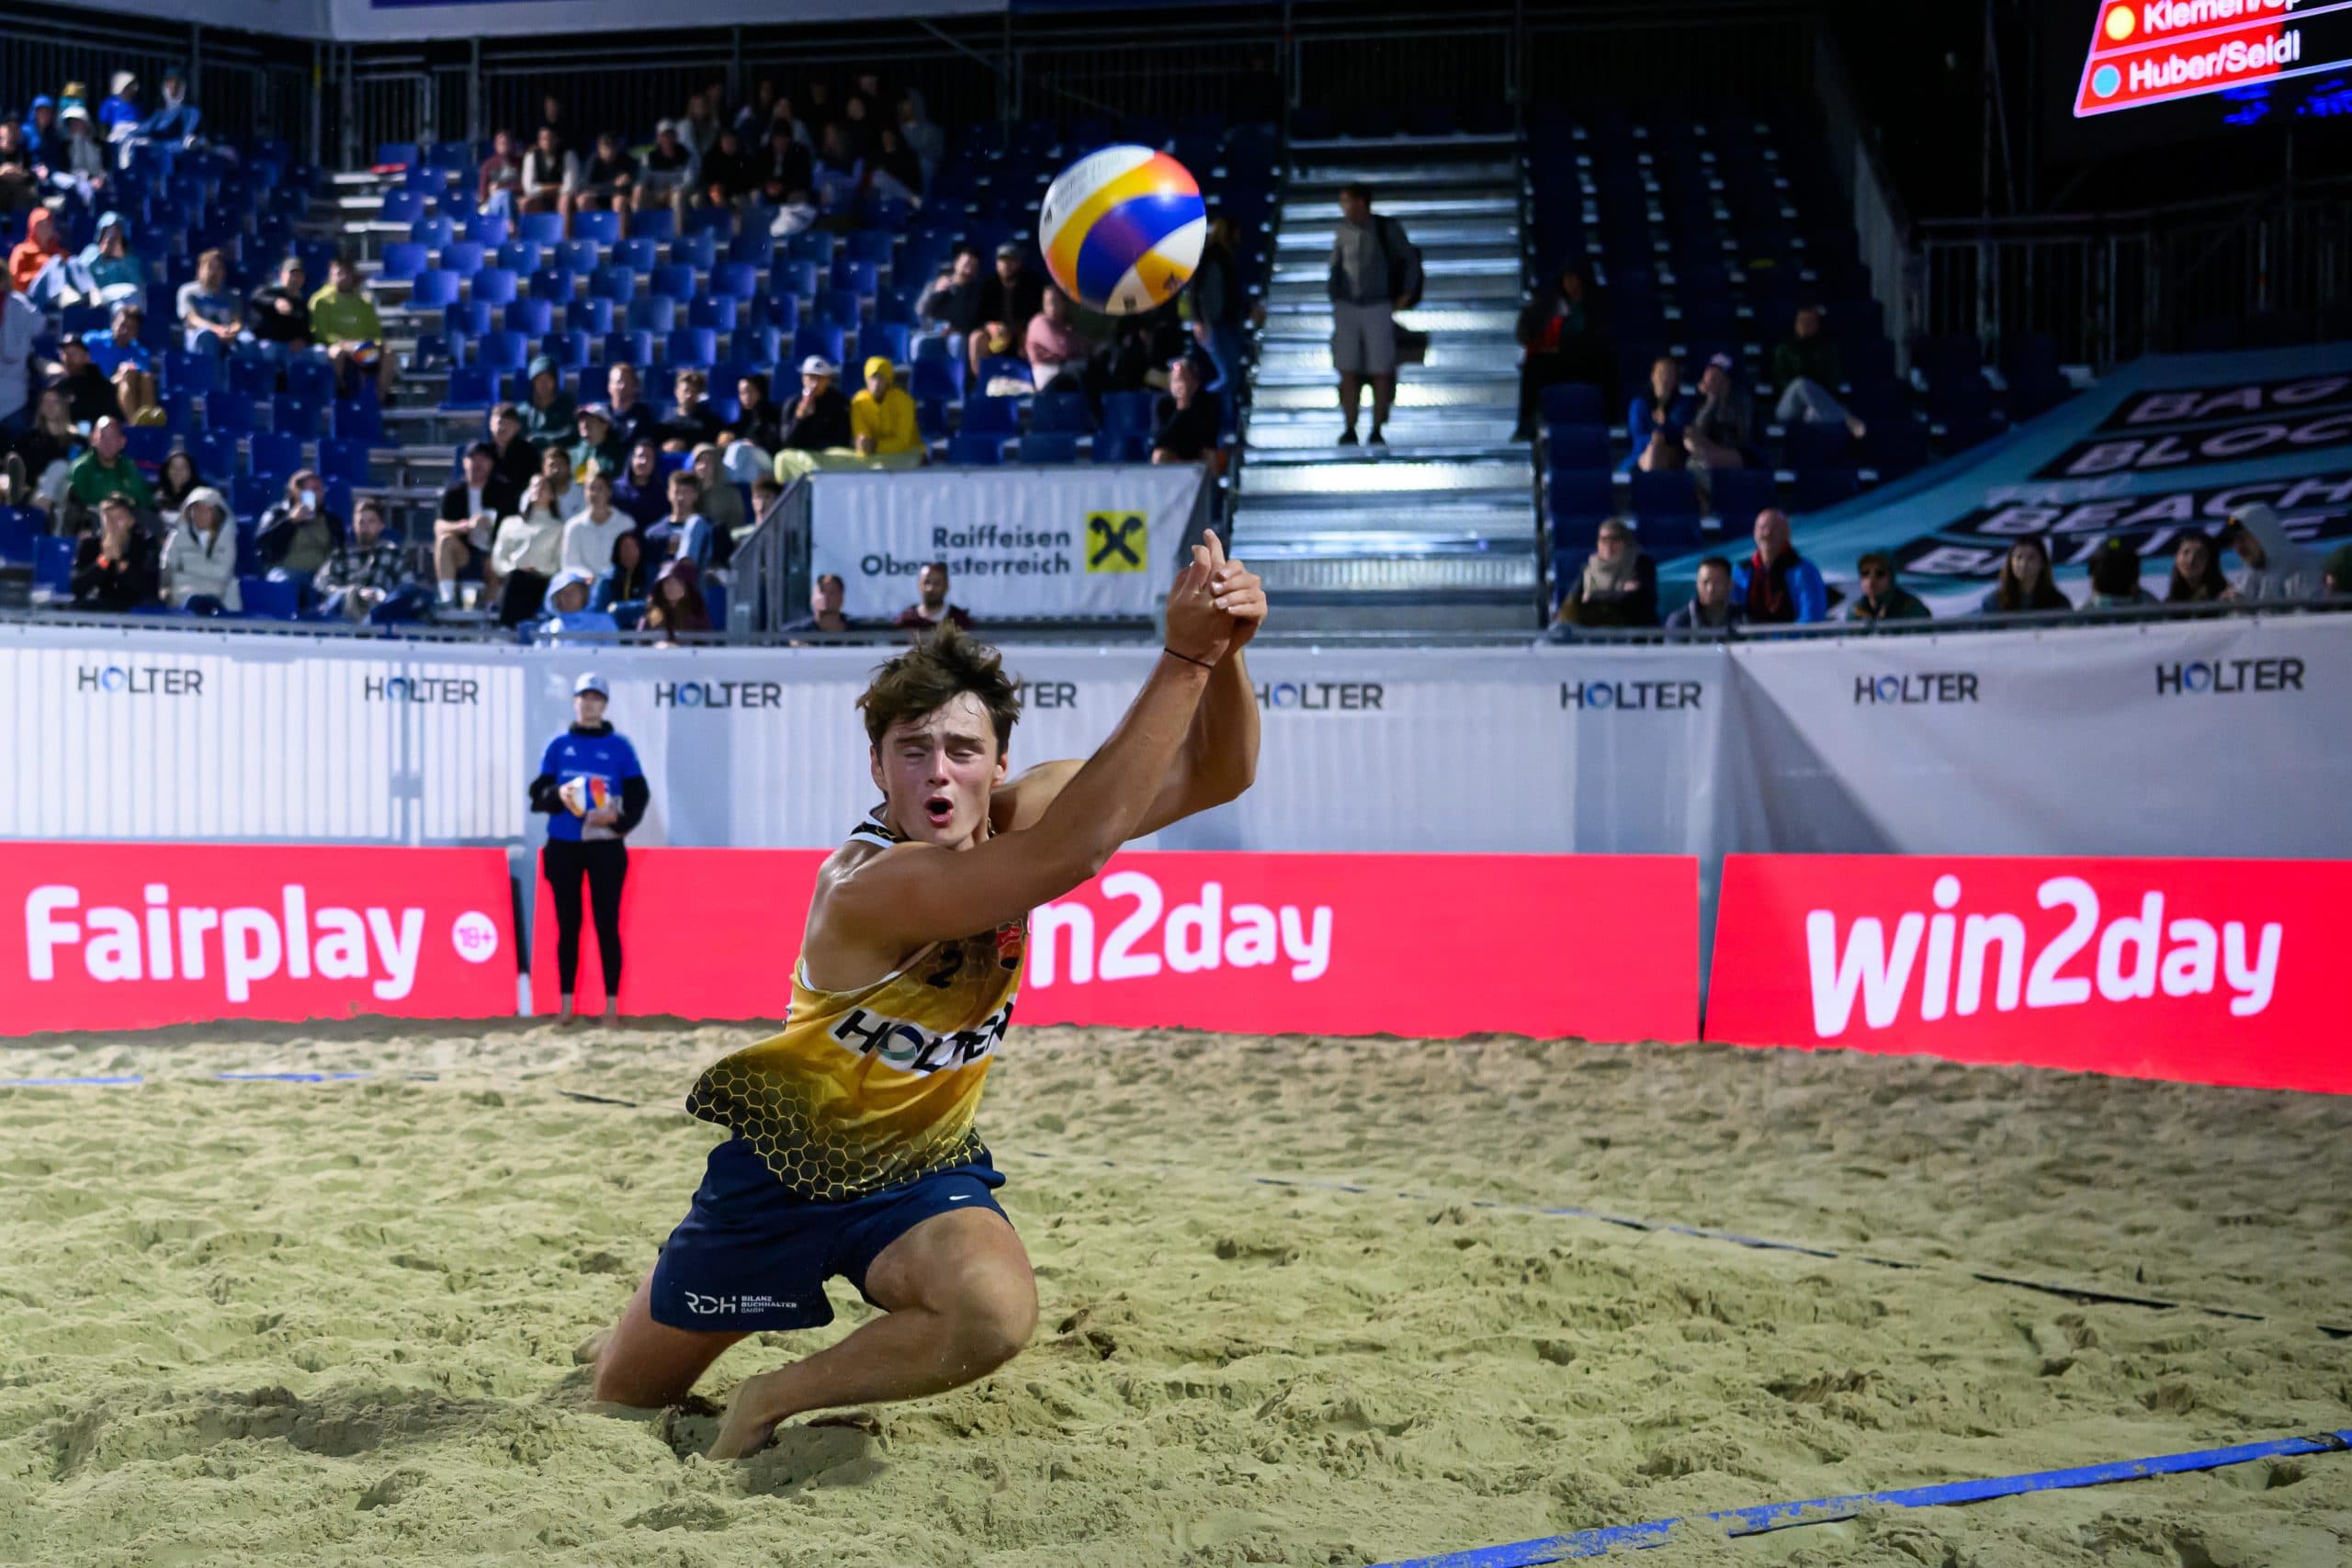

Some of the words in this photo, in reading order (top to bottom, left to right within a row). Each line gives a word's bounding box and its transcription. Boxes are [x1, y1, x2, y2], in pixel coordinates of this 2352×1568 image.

[2130, 30, 2300, 91] Huber/Seidl
[933, 525, 1069, 548] Raiffeisen
[78, 665, 203, 696] HOLTER
[365, 675, 479, 705] HOLTER
[1854, 672, 1979, 705] HOLTER
[2155, 658, 2304, 695] HOLTER
[655, 682, 783, 709] HOLTER
[1560, 681, 1702, 711] HOLTER
[25, 883, 425, 1003] Fairplay
[458, 926, 494, 949] 18+
[1027, 870, 1333, 989] n2day
[925, 946, 965, 989] 2
[684, 1291, 737, 1314] RDH
